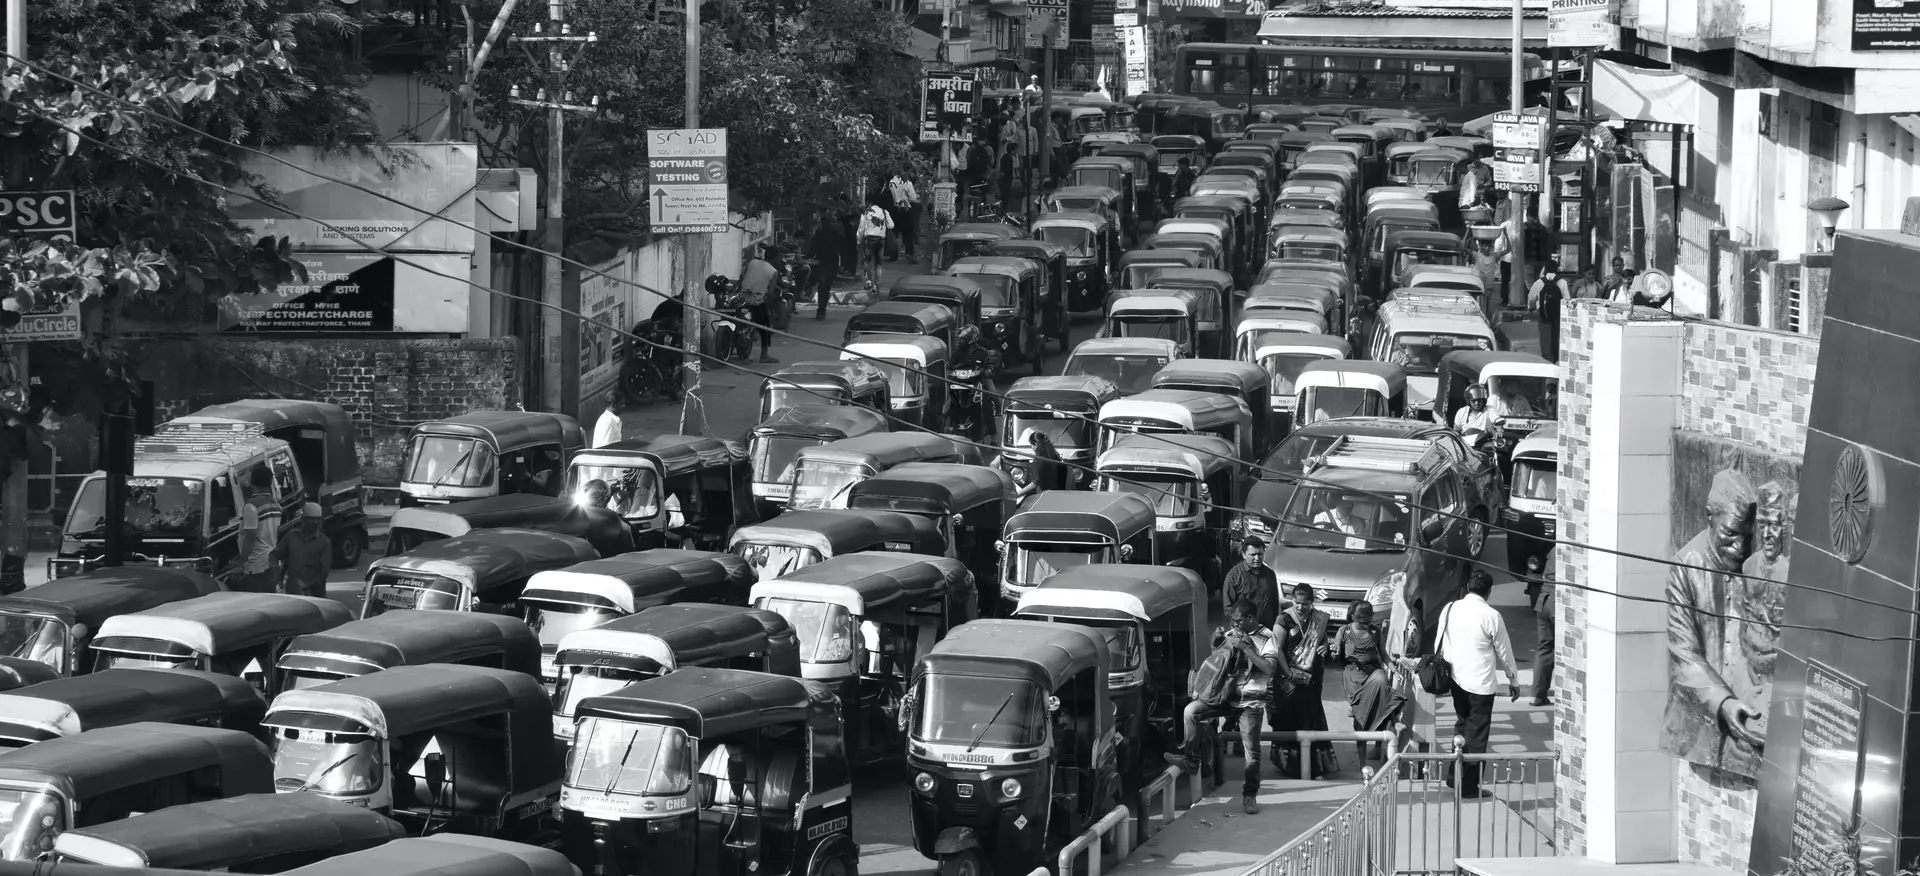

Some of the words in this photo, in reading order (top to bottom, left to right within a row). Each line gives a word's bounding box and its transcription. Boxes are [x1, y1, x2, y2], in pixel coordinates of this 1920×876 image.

[1493, 114, 1518, 122] LEARN
[650, 160, 705, 168] SOFTWARE
[656, 173, 700, 181] TESTING
[665, 798, 687, 810] CNG
